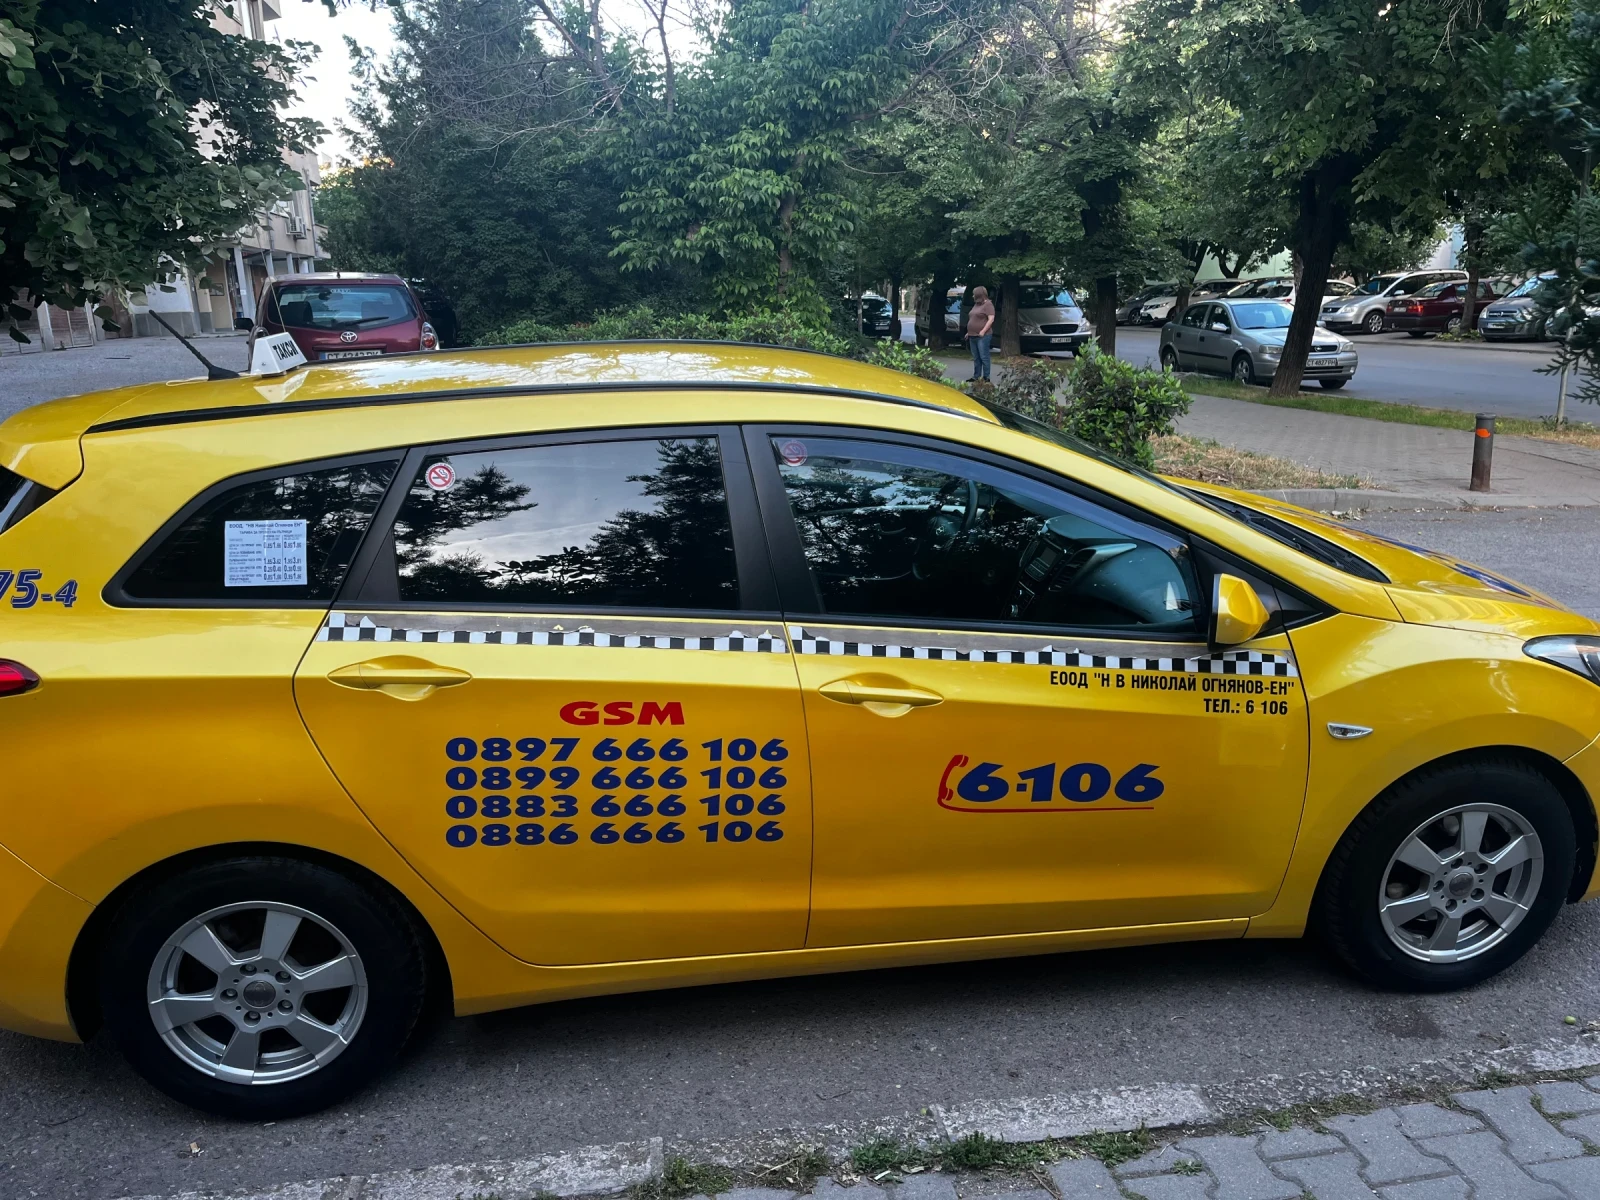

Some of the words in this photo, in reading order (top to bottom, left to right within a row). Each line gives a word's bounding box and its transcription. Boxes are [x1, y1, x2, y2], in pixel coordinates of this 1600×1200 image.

[272, 340, 299, 361] ТАКСИ
[1050, 671, 1089, 689] ЕООД
[1094, 673, 1110, 688] "Н
[1116, 674, 1125, 688] В
[1131, 675, 1196, 692] НИКОЛАЙ
[1202, 677, 1295, 696] ОГНЯНОВ-ЕН"
[559, 701, 685, 726] GSM
[1203, 698, 1240, 714] ТЕЛ.:
[1245, 700, 1255, 714] 6
[1261, 700, 1288, 715] 106
[445, 737, 581, 762] 0897
[592, 737, 689, 762] 666
[701, 738, 789, 762] 106
[445, 766, 580, 791] 0899
[591, 766, 688, 790] 666
[700, 766, 788, 790] 106
[445, 795, 579, 819] 0883
[590, 794, 687, 819] 666
[698, 793, 786, 817] 106
[445, 823, 579, 848] 0886
[590, 822, 686, 845] 666
[697, 821, 784, 843] 106
